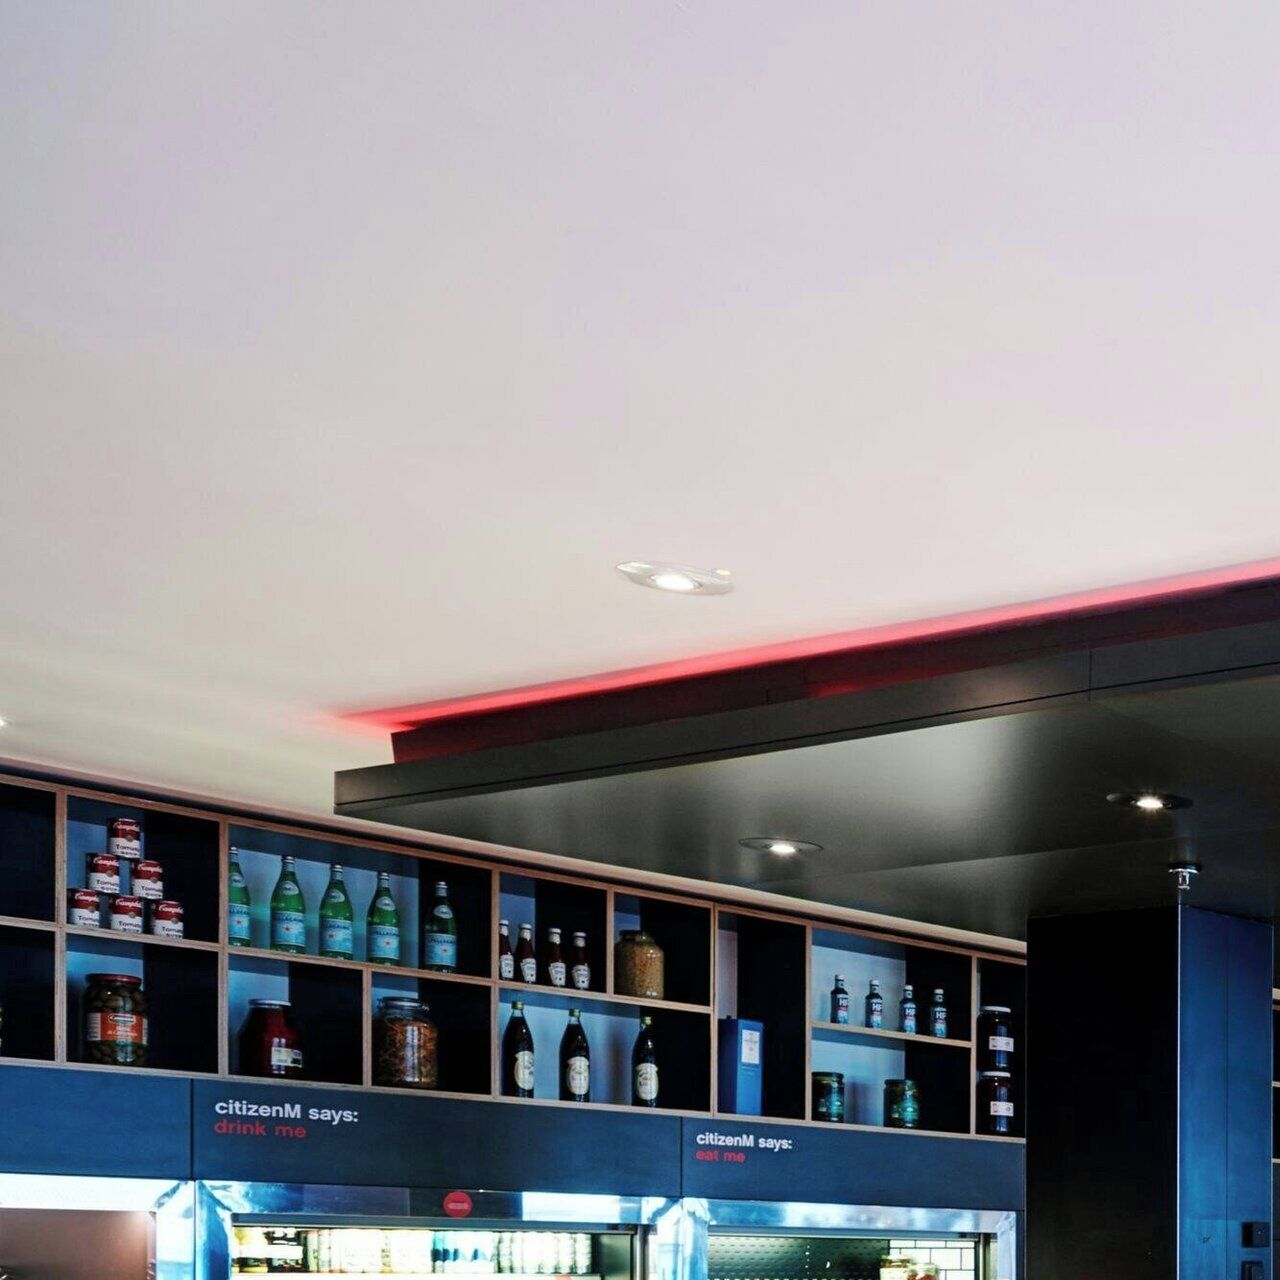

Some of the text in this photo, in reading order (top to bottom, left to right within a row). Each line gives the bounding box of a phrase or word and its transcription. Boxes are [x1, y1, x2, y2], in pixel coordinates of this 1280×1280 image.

[215, 1100, 359, 1125] citizenM says:
[214, 1119, 306, 1138] drink me
[696, 1132, 793, 1152] citizenM says:
[696, 1150, 746, 1162] eat me
